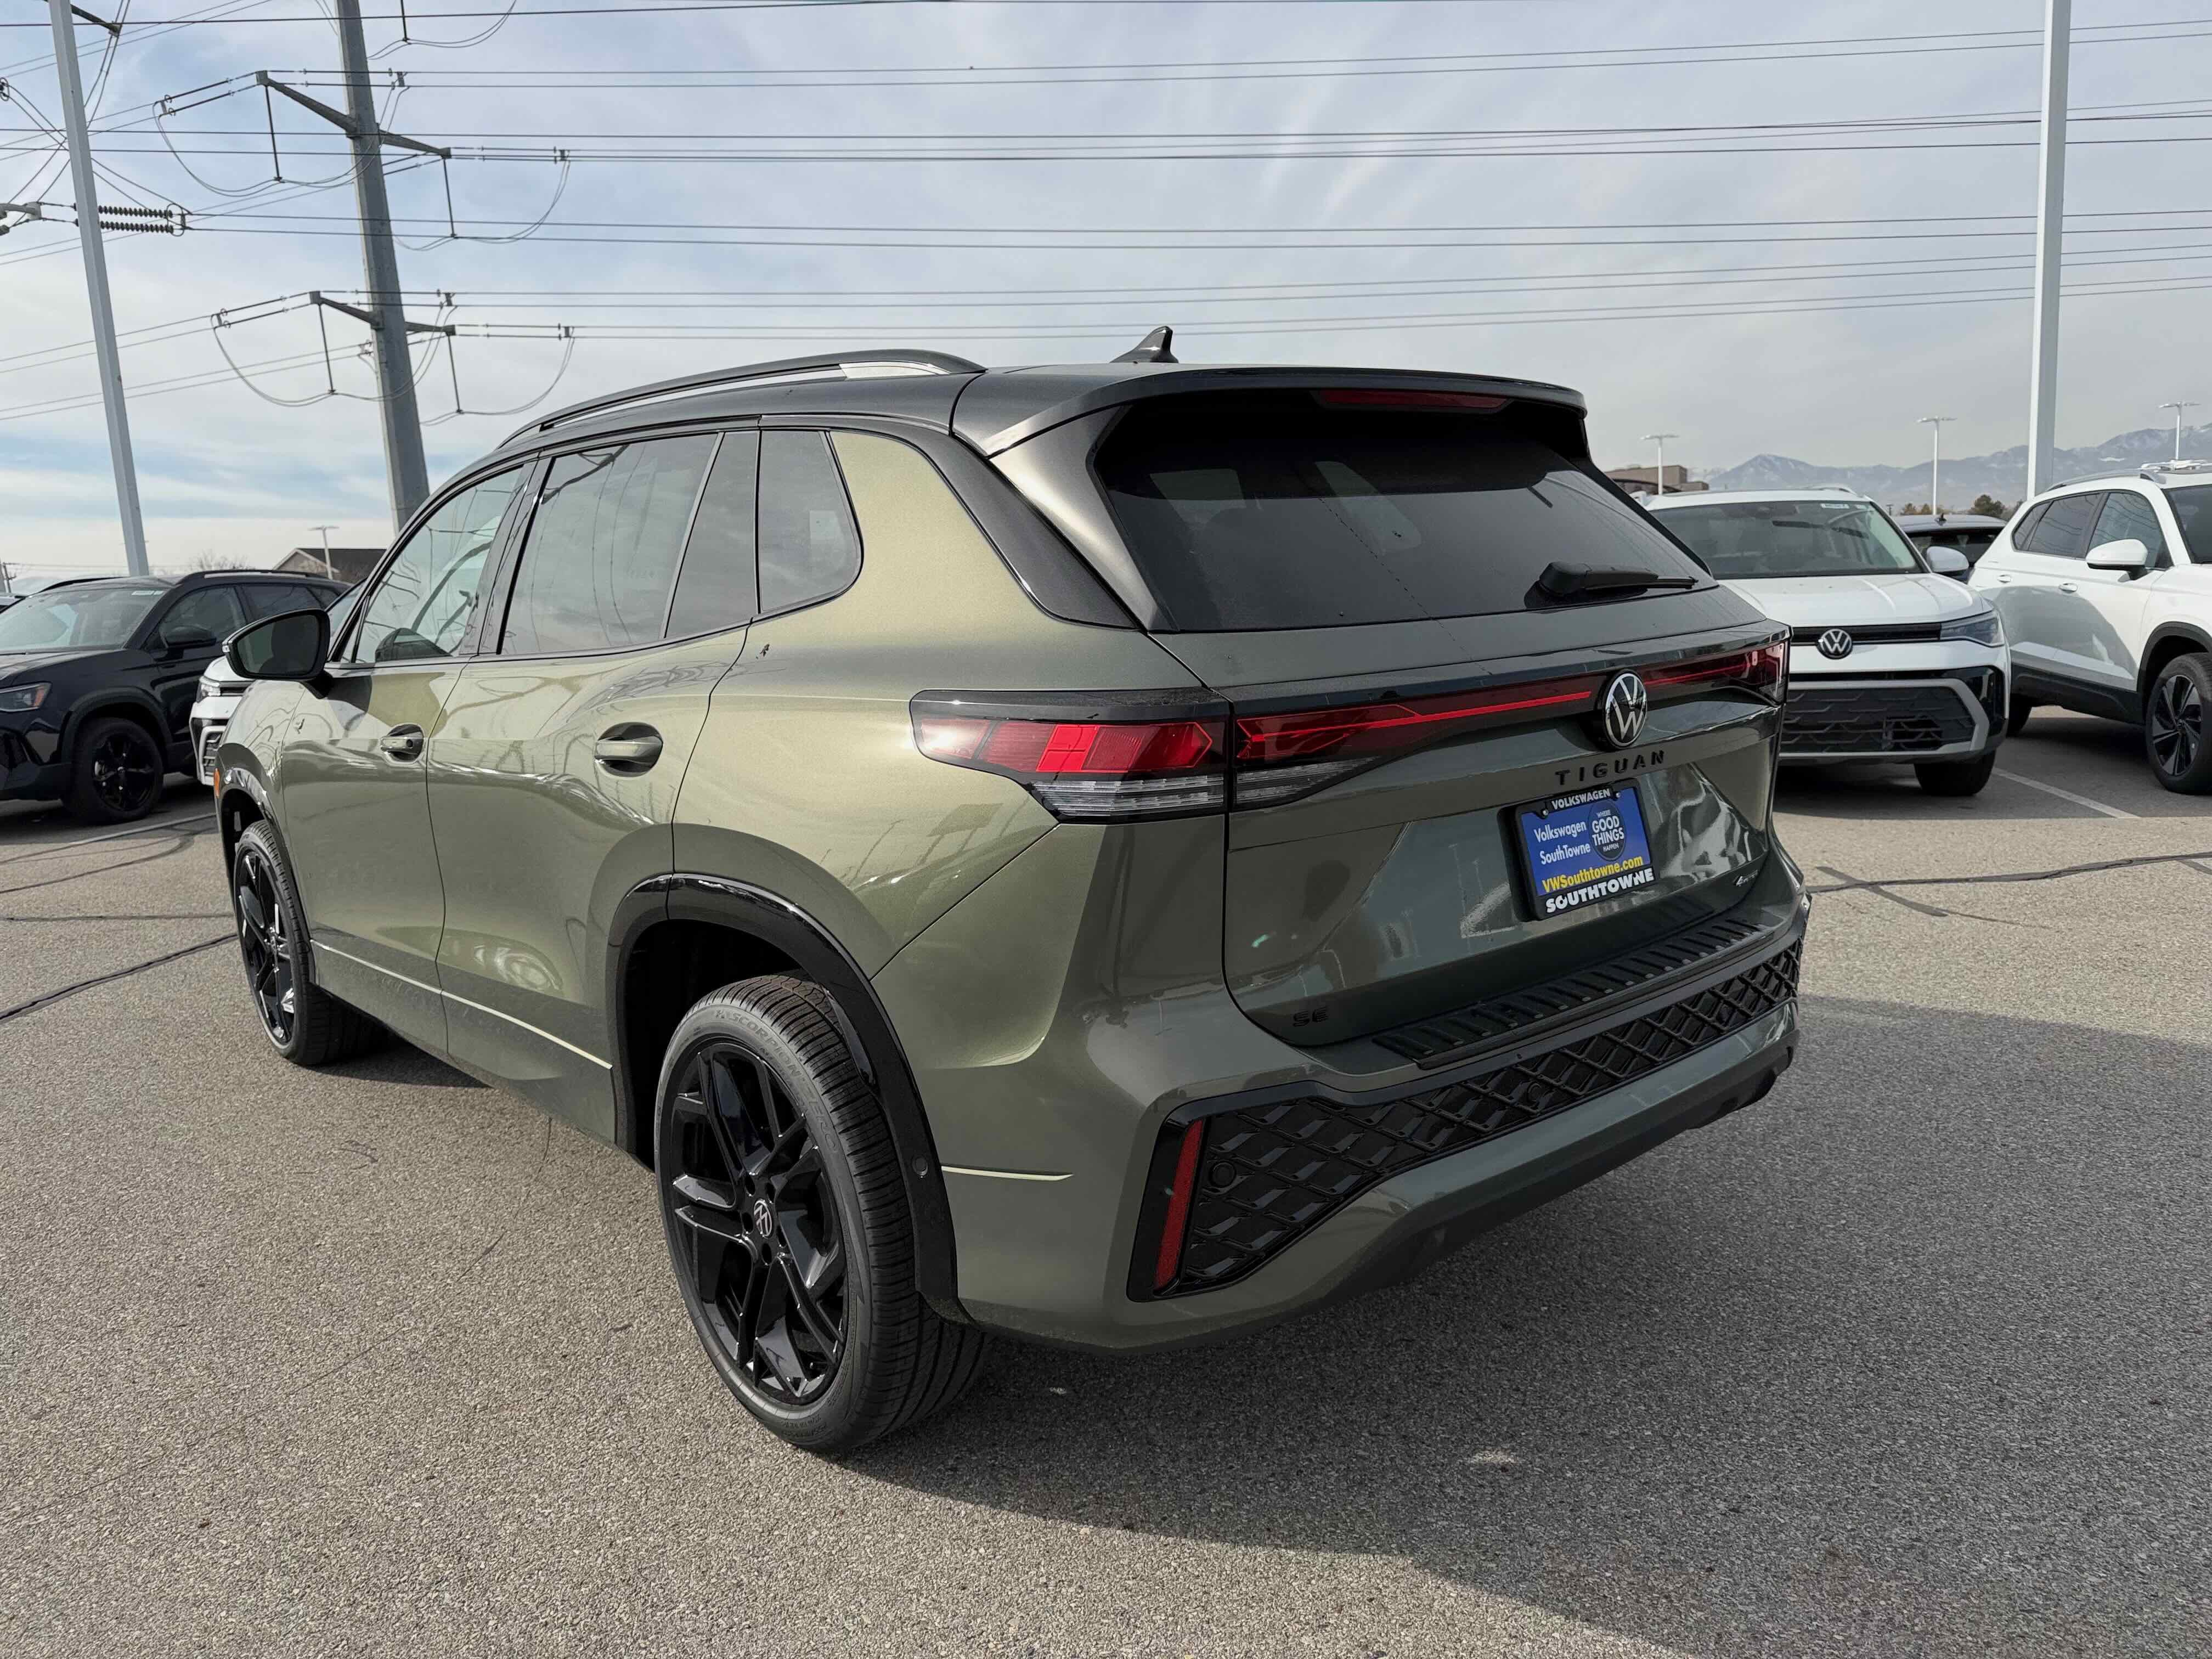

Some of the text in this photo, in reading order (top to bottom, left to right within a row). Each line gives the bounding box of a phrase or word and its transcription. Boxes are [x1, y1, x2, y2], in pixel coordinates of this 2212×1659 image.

[1555, 750, 1665, 786] TIGUAN
[1551, 788, 1611, 810] VOLKSWAGEN
[1534, 821, 1586, 843] Volkswagen
[1592, 815, 1620, 833] GOOD
[1592, 827, 1624, 846] THINGS
[1603, 843, 1619, 852] HAPPEN
[1540, 843, 1590, 865] SouthTowne
[1542, 856, 1643, 893] VWSouthtowne.com
[1545, 868, 1654, 913] SOUTHTOWNE
[1293, 1006, 1328, 1027] SE
[732, 1012, 802, 1076] SCORPION
[802, 1084, 838, 1153] ZERO
